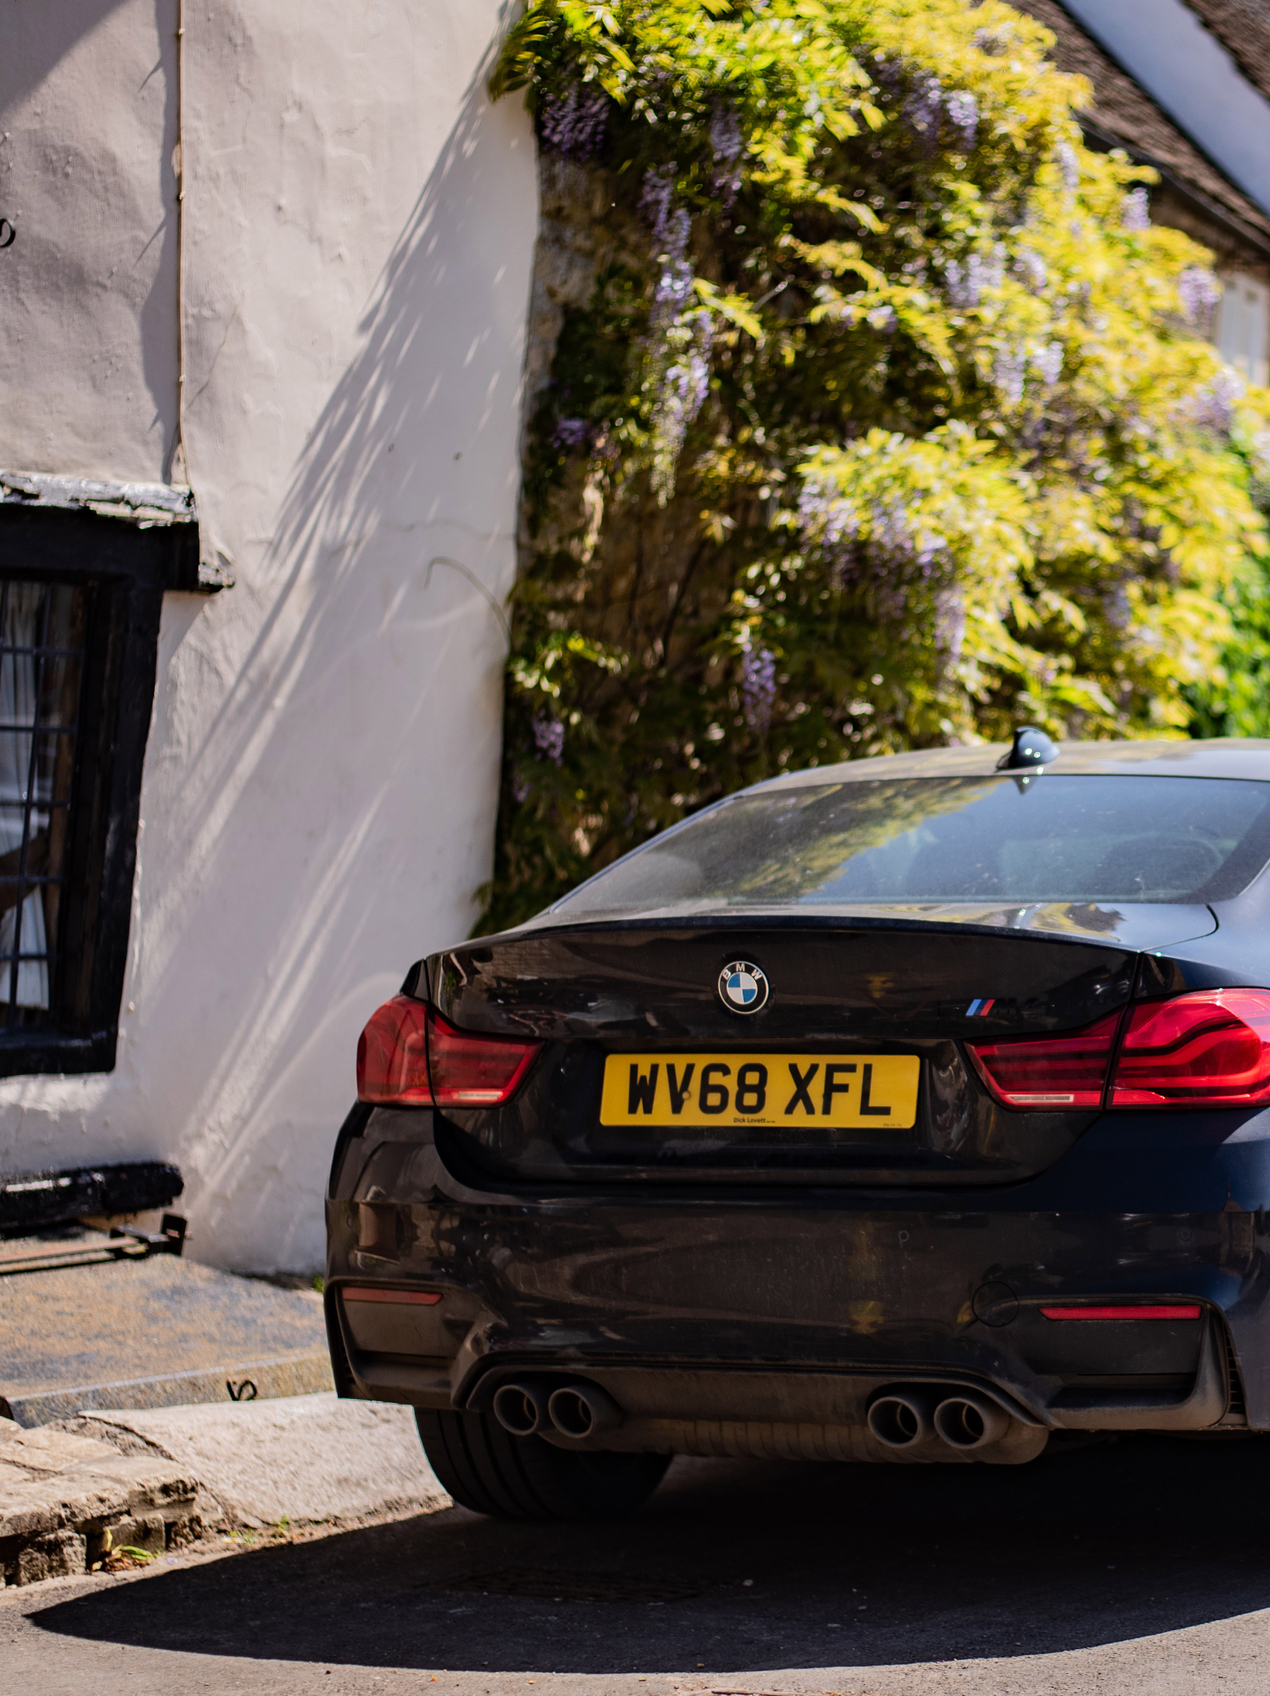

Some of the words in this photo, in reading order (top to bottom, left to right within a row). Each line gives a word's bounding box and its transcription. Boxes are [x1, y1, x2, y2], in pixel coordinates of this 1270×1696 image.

[722, 963, 763, 980] BMW
[628, 1063, 768, 1115] WV68
[784, 1063, 892, 1116] XFL
